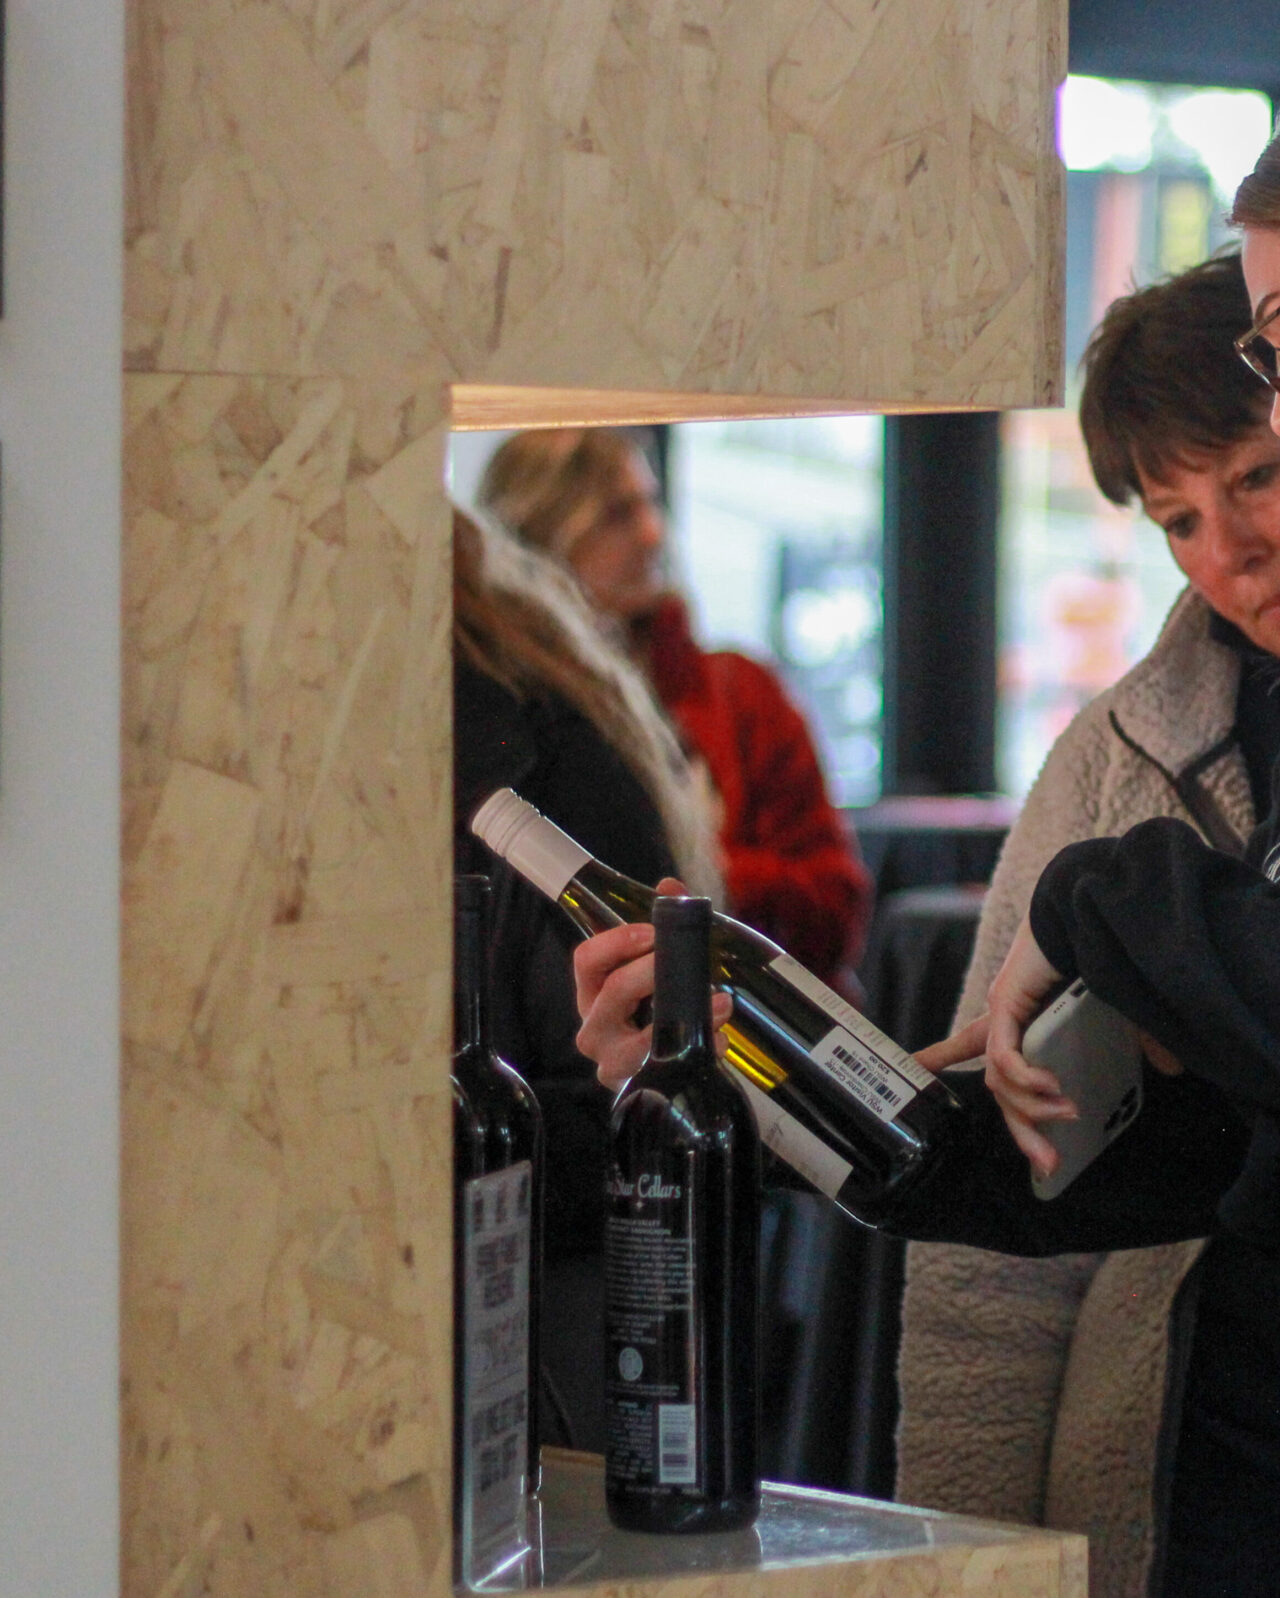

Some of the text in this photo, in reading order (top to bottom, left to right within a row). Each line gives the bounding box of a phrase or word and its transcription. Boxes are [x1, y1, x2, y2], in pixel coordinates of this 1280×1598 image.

[824, 1061, 846, 1082] Center
[845, 1080, 867, 1100] Visitor
[637, 1173, 682, 1199] Cellars
